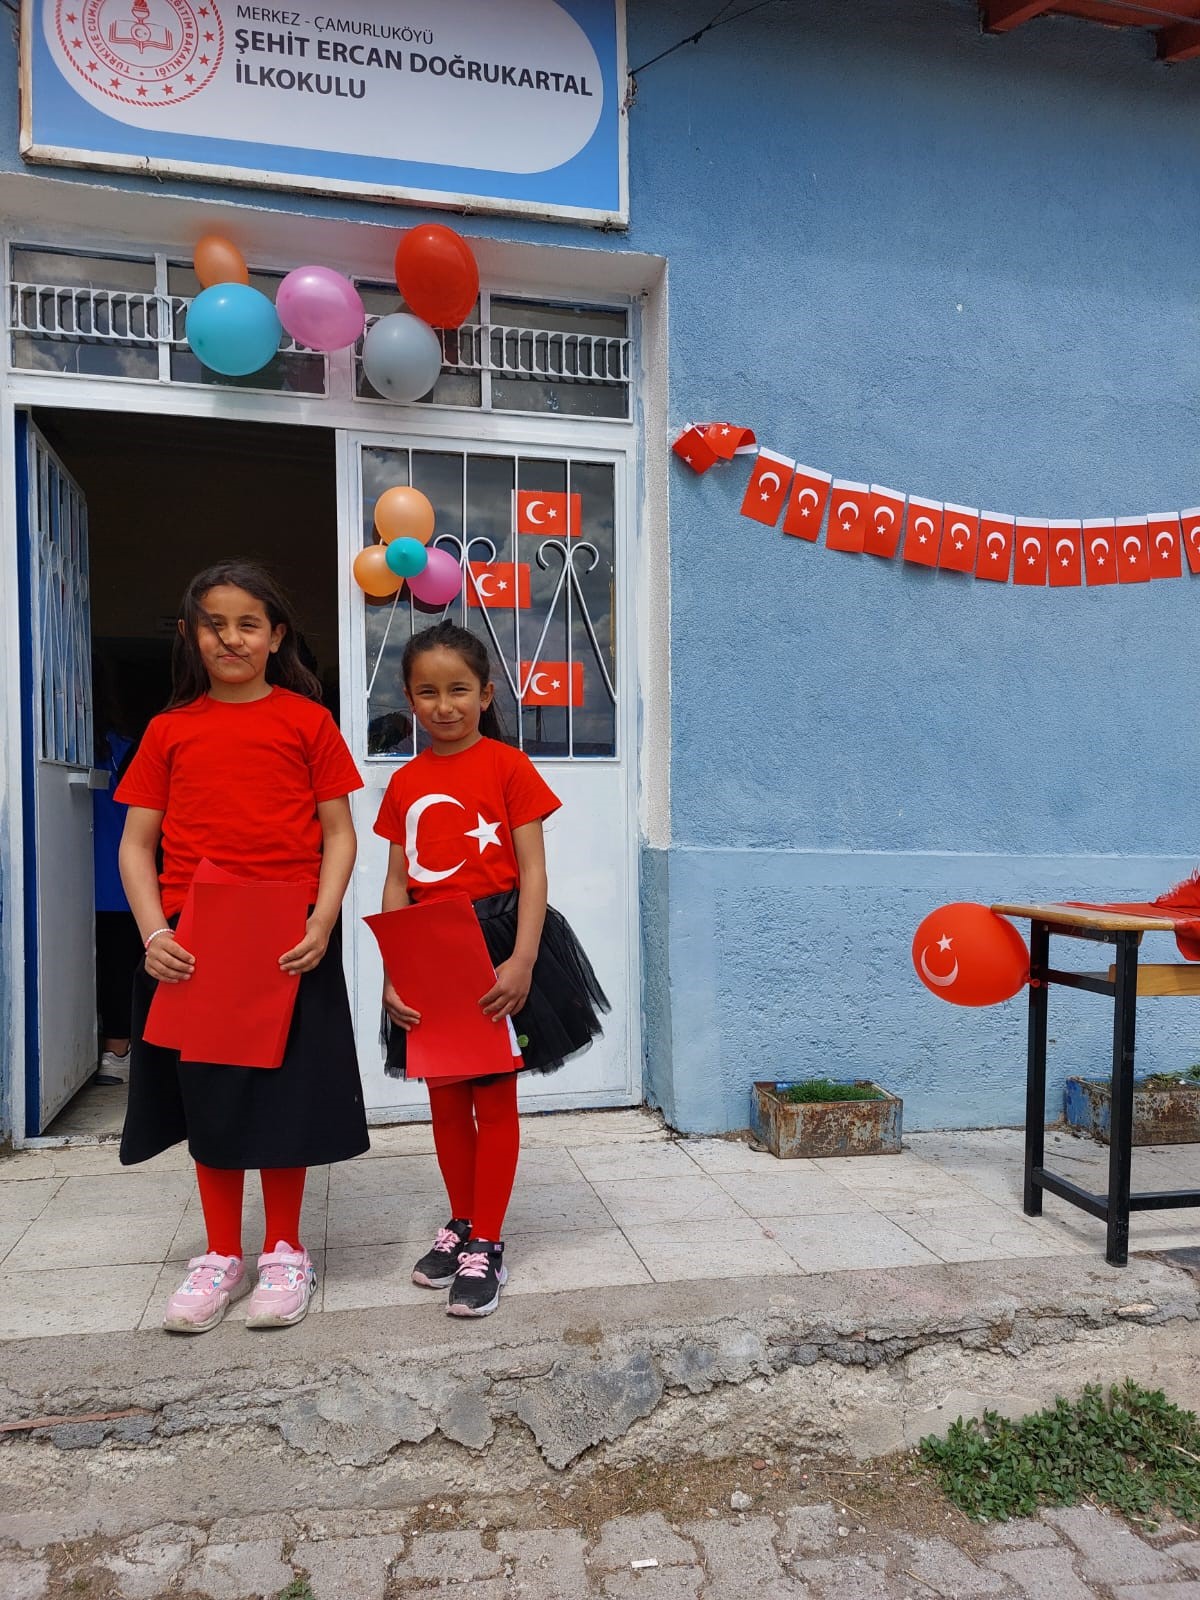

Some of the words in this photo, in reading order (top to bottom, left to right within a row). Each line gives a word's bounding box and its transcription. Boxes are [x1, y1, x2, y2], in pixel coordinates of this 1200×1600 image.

[236, 5, 301, 27] MERKEZ
[314, 16, 434, 45] ÇAMURLUKÖYÜ
[154, 32, 194, 77] BAKANLIĞI
[235, 28, 311, 58] ŞEHİT
[318, 40, 403, 71] ERCAN
[410, 53, 593, 97] DOĞRUKARTAL
[235, 58, 366, 99] İLKOKULU
